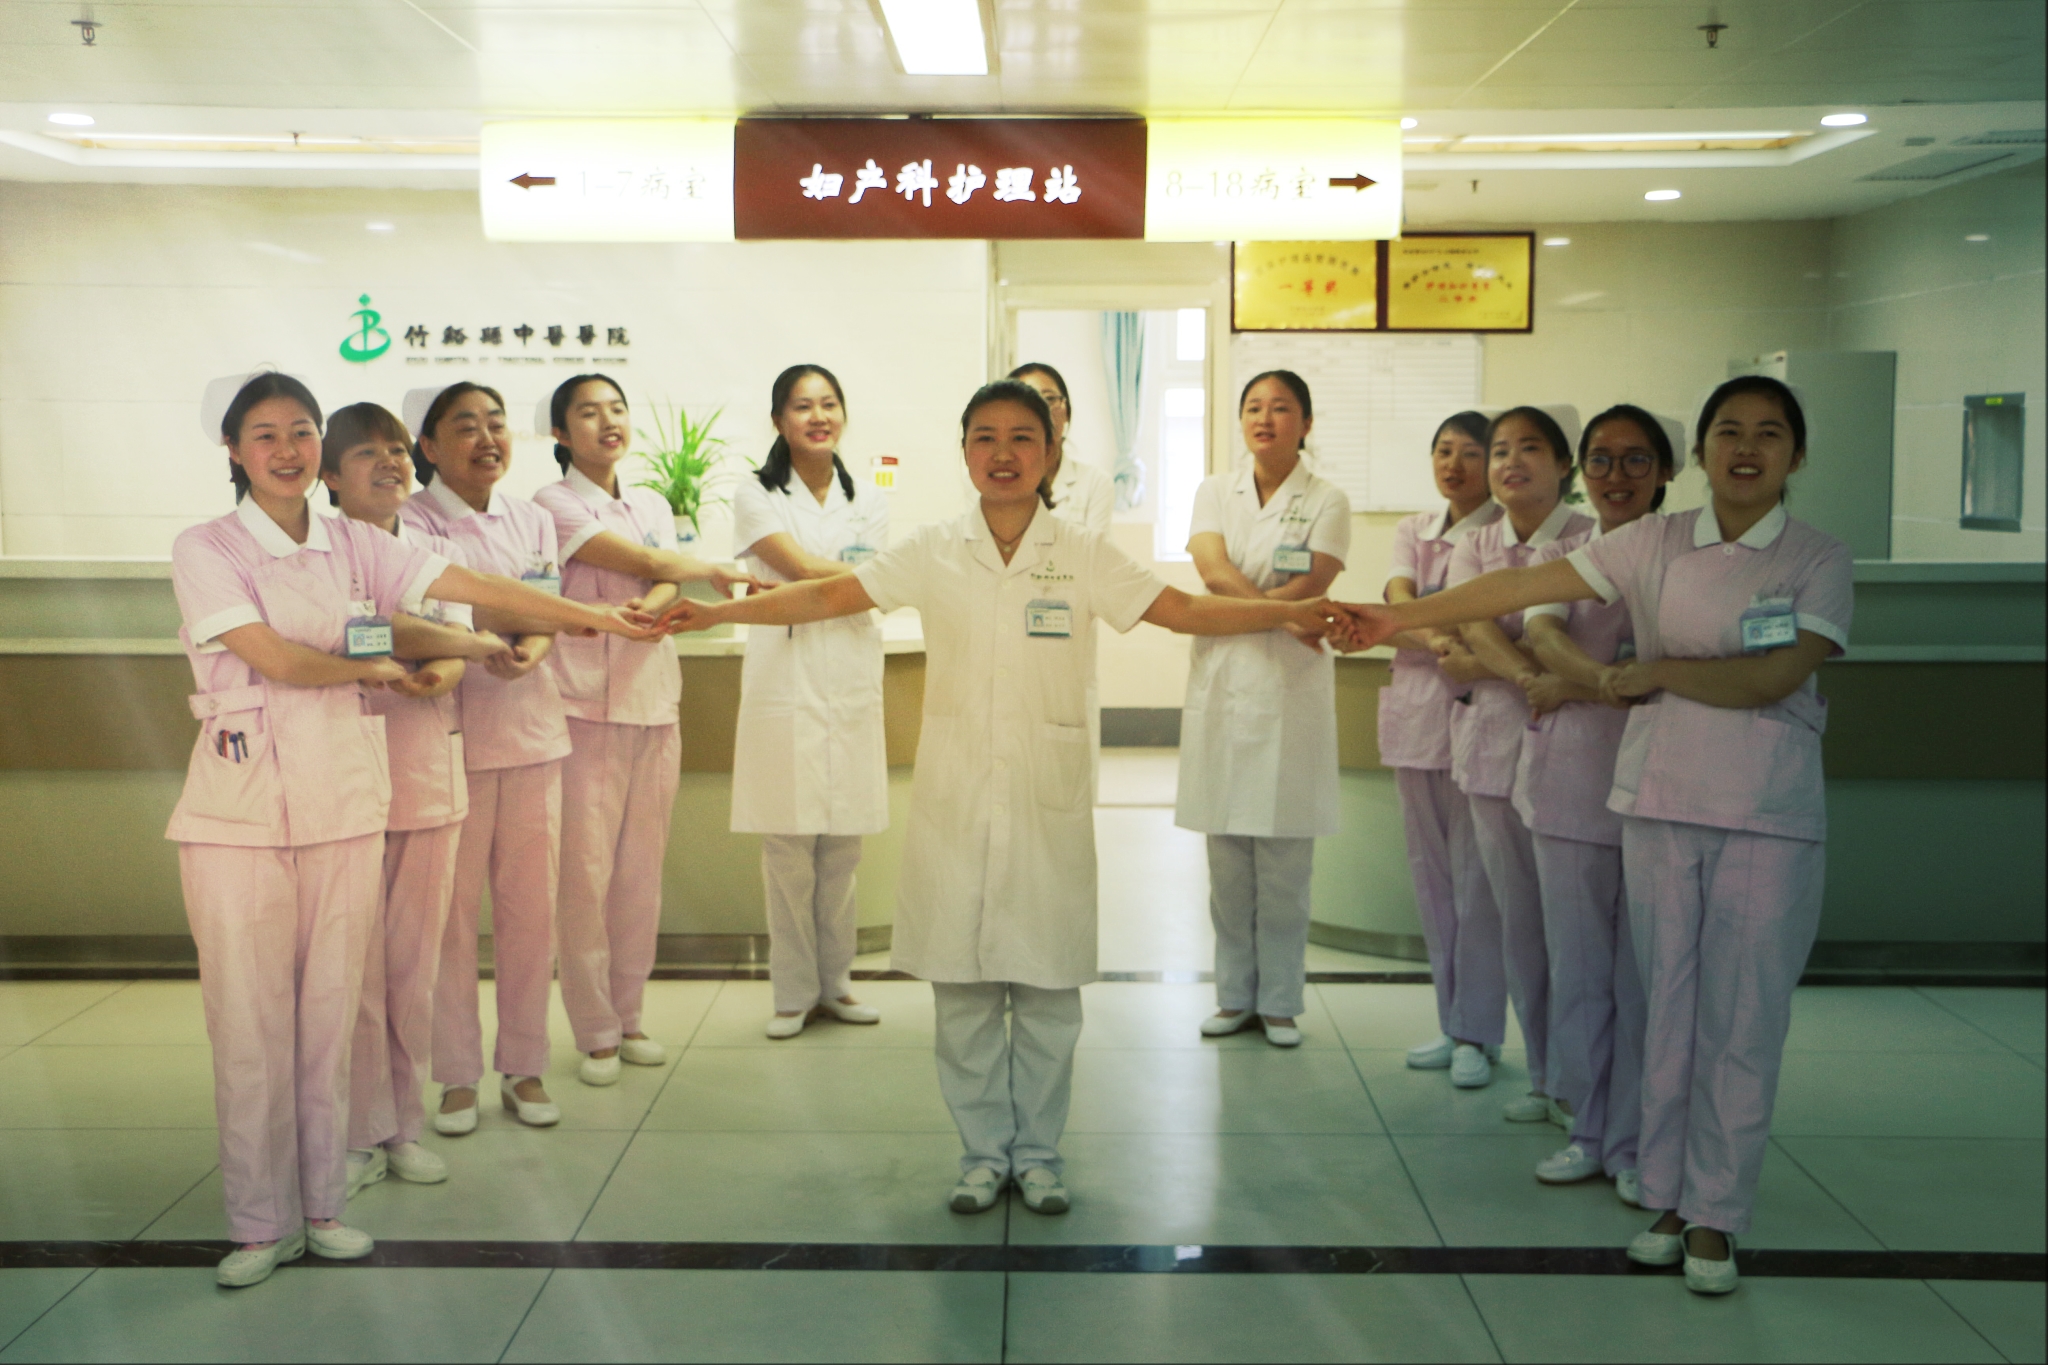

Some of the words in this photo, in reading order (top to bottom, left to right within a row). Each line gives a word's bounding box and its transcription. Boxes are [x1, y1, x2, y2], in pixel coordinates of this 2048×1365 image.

[800, 158, 1082, 208] 妇产科护理站
[1166, 165, 1316, 200] 8-18病室
